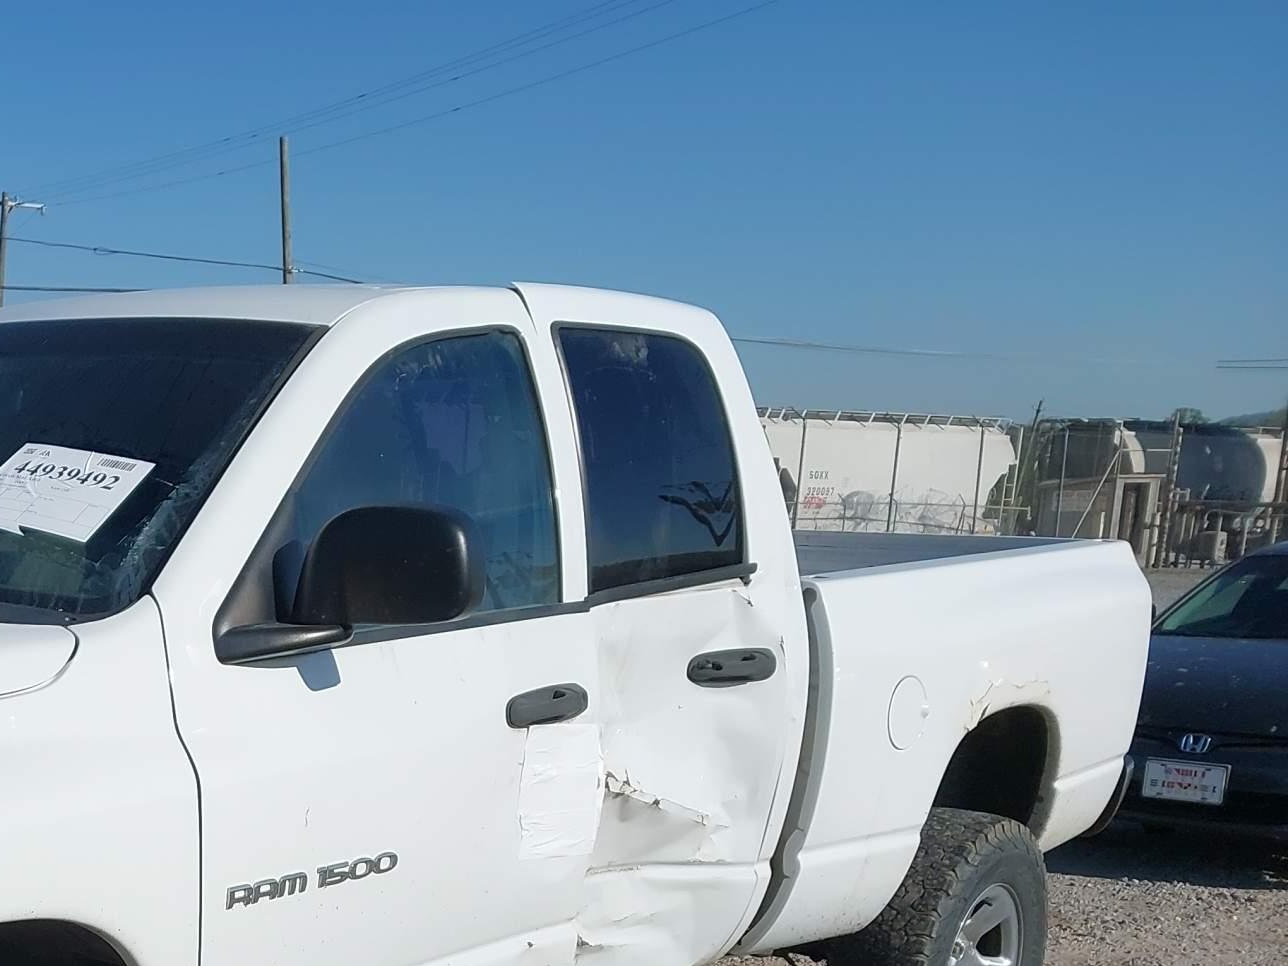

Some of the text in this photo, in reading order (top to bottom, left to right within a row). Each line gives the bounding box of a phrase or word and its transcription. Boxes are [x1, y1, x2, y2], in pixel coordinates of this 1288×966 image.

[13, 460, 120, 489] 44939492
[225, 850, 399, 910] RAM 1500
